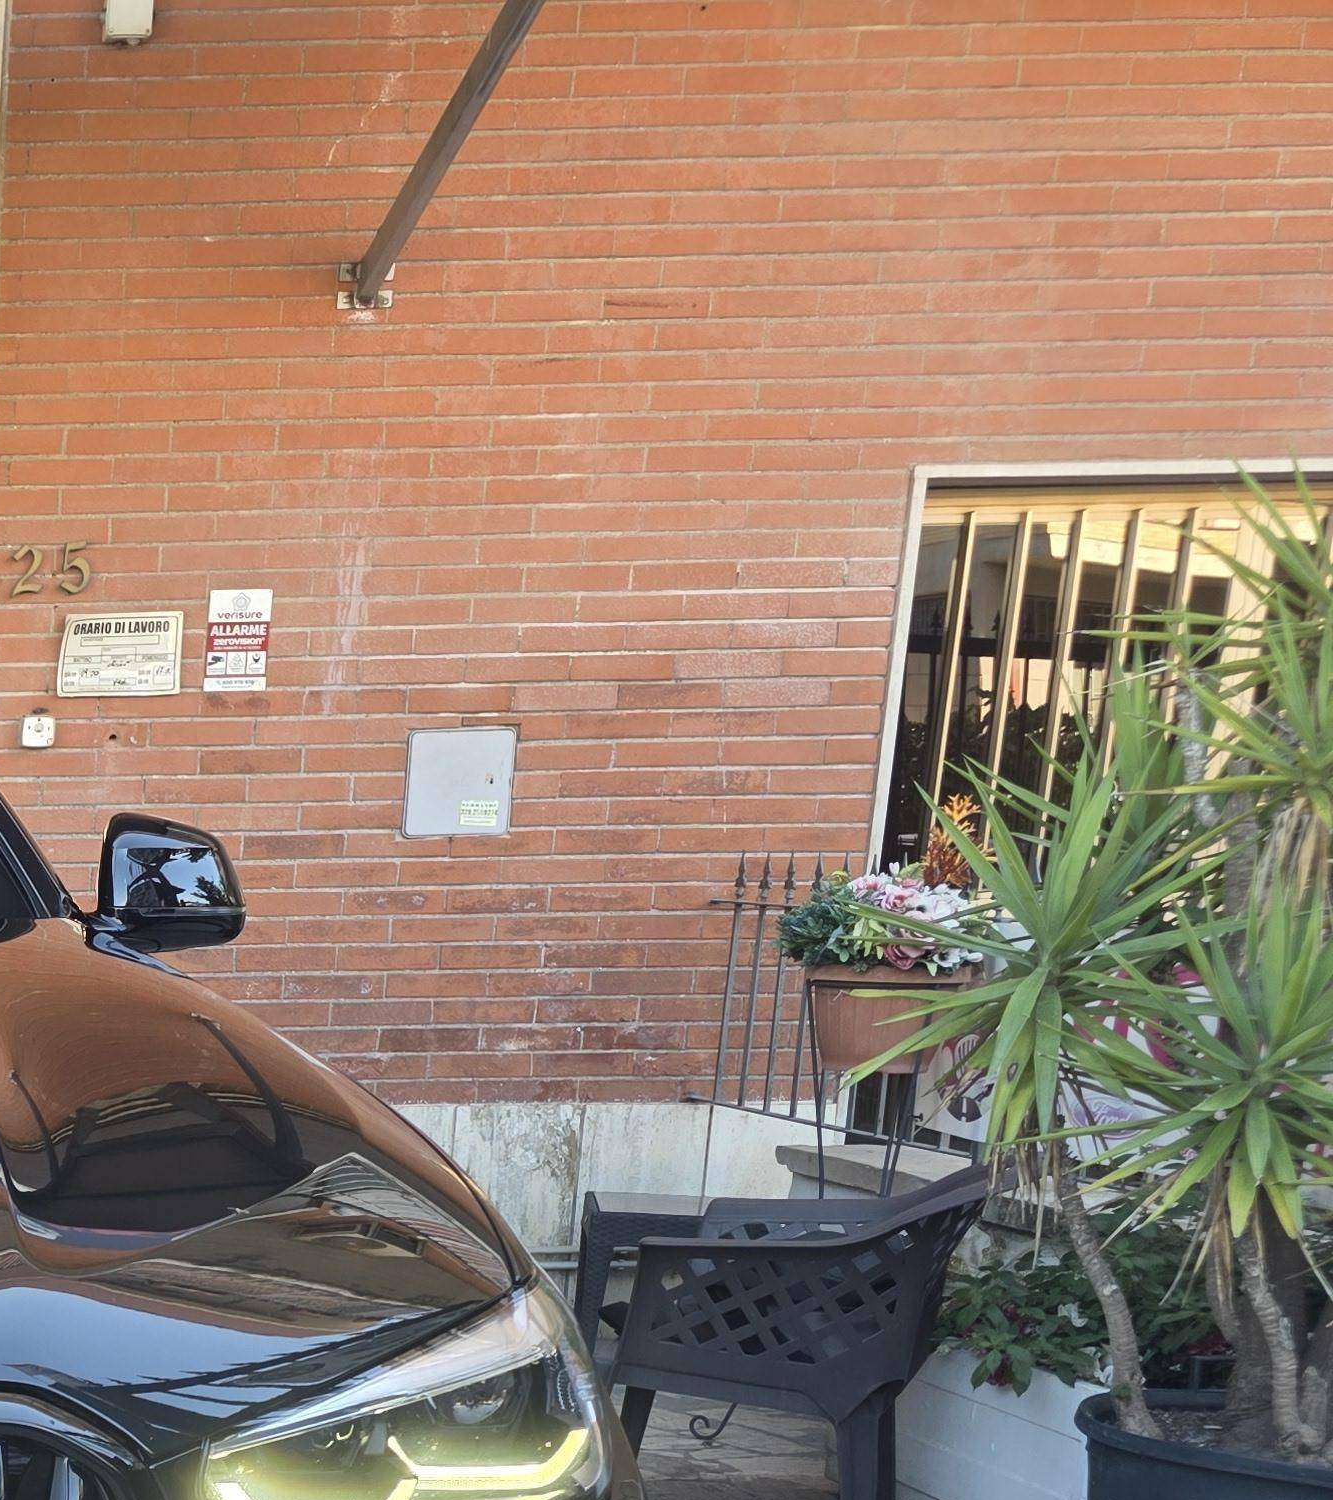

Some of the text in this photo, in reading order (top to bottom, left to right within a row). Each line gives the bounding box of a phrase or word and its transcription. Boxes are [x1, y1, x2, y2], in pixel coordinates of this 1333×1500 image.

[11, 541, 91, 598] 25
[217, 611, 263, 619] verisure
[74, 620, 170, 635] ORARIO DI LAVORO
[210, 624, 268, 636] ALLARME
